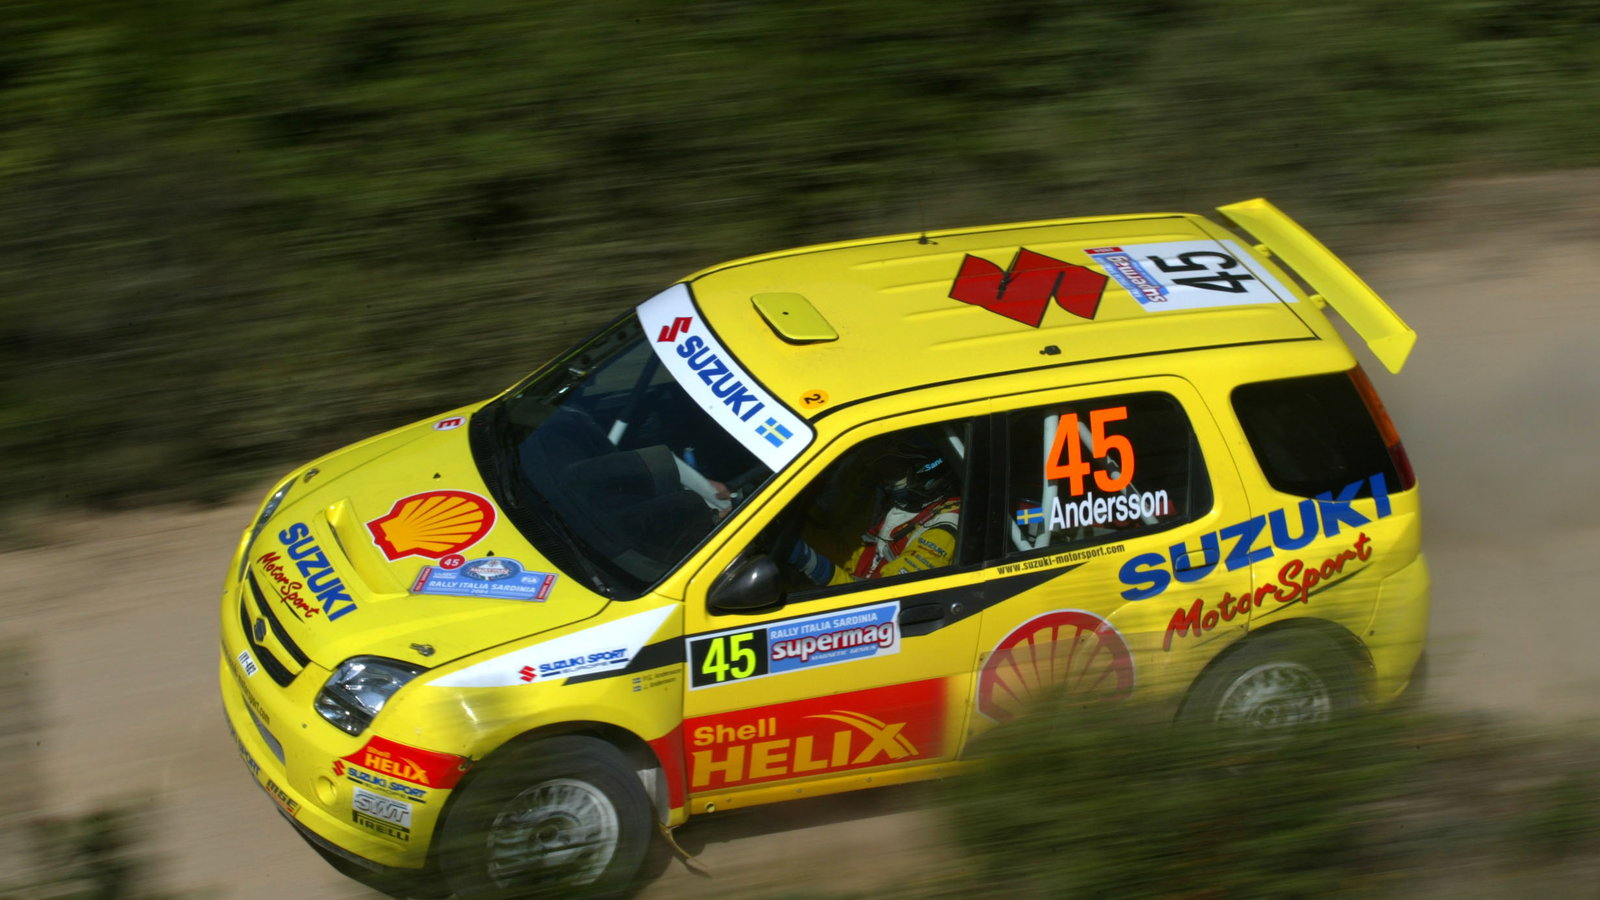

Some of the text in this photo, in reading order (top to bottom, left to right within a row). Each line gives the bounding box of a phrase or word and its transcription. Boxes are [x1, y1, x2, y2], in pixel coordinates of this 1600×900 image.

[1105, 255, 1168, 303] supermag
[1146, 250, 1256, 293] 45
[676, 335, 765, 422] SUZUKI
[1045, 406, 1135, 497] 45
[1048, 489, 1169, 532] Andersson
[1118, 472, 1392, 601] SUZUKI
[278, 522, 357, 622] SUZUKI
[444, 558, 459, 567] 45
[996, 544, 1125, 575] www.suzuki-motorsport.com
[256, 551, 320, 618] MotorSport
[429, 580, 536, 593] RALLY ITALIA SARDINIA
[1162, 532, 1372, 651] MotorSport
[770, 612, 878, 640] RALLY ITALIA SARDINIA
[771, 622, 894, 662] supermag
[538, 648, 627, 672] SUZUKI SPORT
[702, 632, 756, 682] 45
[691, 710, 919, 787] HELIX
[693, 717, 777, 747] Shell
[347, 767, 427, 798] SUZUKI SPORT
[364, 753, 430, 785] HELIX
[352, 809, 410, 842] PIRELLI
